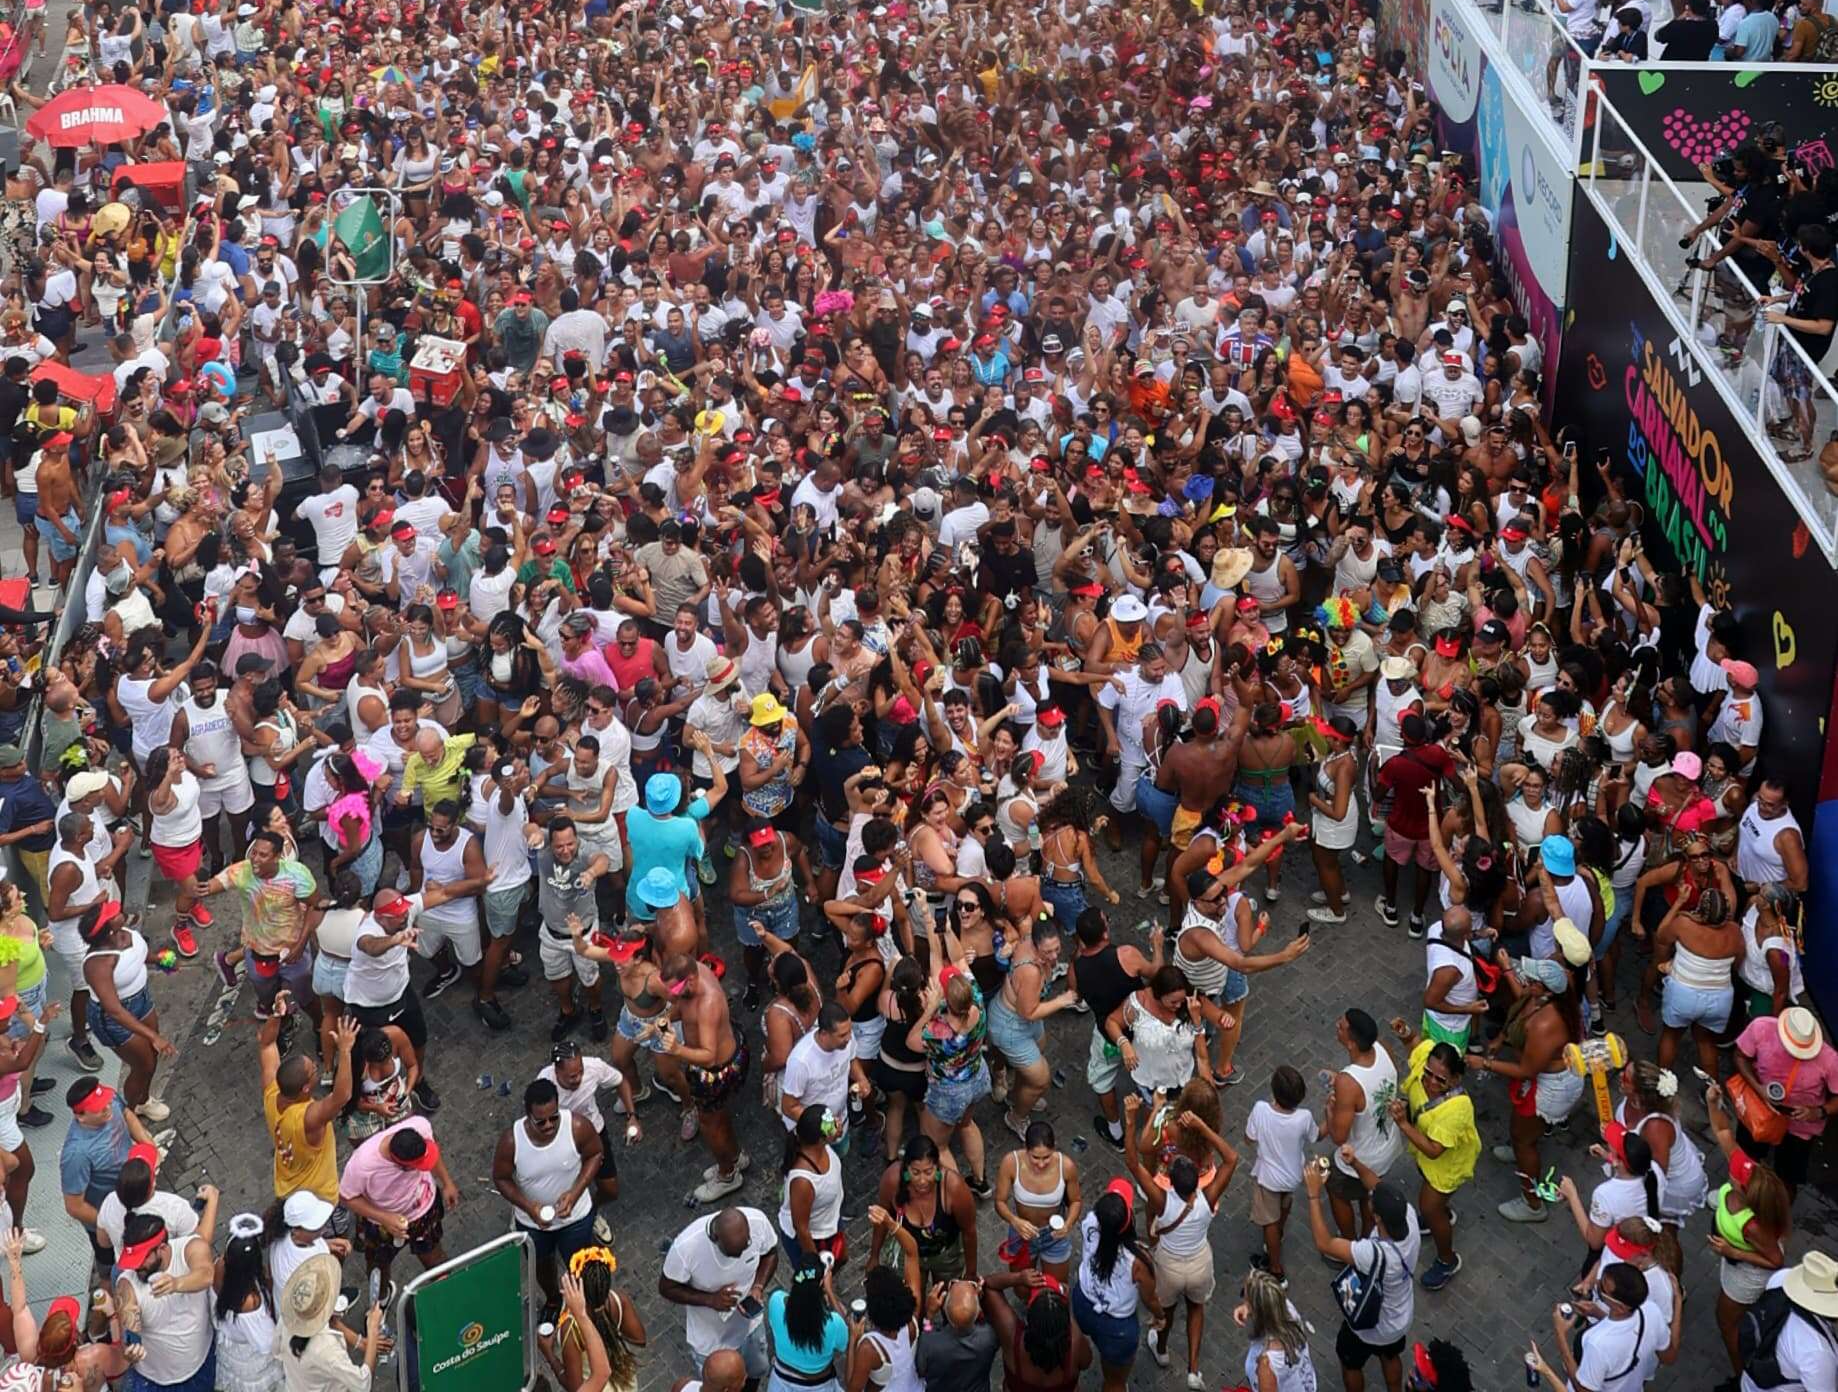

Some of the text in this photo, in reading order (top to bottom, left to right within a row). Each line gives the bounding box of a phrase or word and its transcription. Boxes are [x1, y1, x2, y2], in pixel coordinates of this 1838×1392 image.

[1435, 15, 1470, 94] FOLIA
[60, 107, 124, 129] BRAHMA
[1537, 170, 1563, 224] RECORD
[1502, 245, 1531, 321] BAHIA
[1625, 363, 1714, 552] CARNAVAL
[1628, 419, 1647, 468] DO
[1643, 339, 1734, 521] SALVADOR
[432, 1355, 461, 1374] Costa
[461, 1346, 476, 1360] do
[476, 1330, 510, 1352] Sauípe
